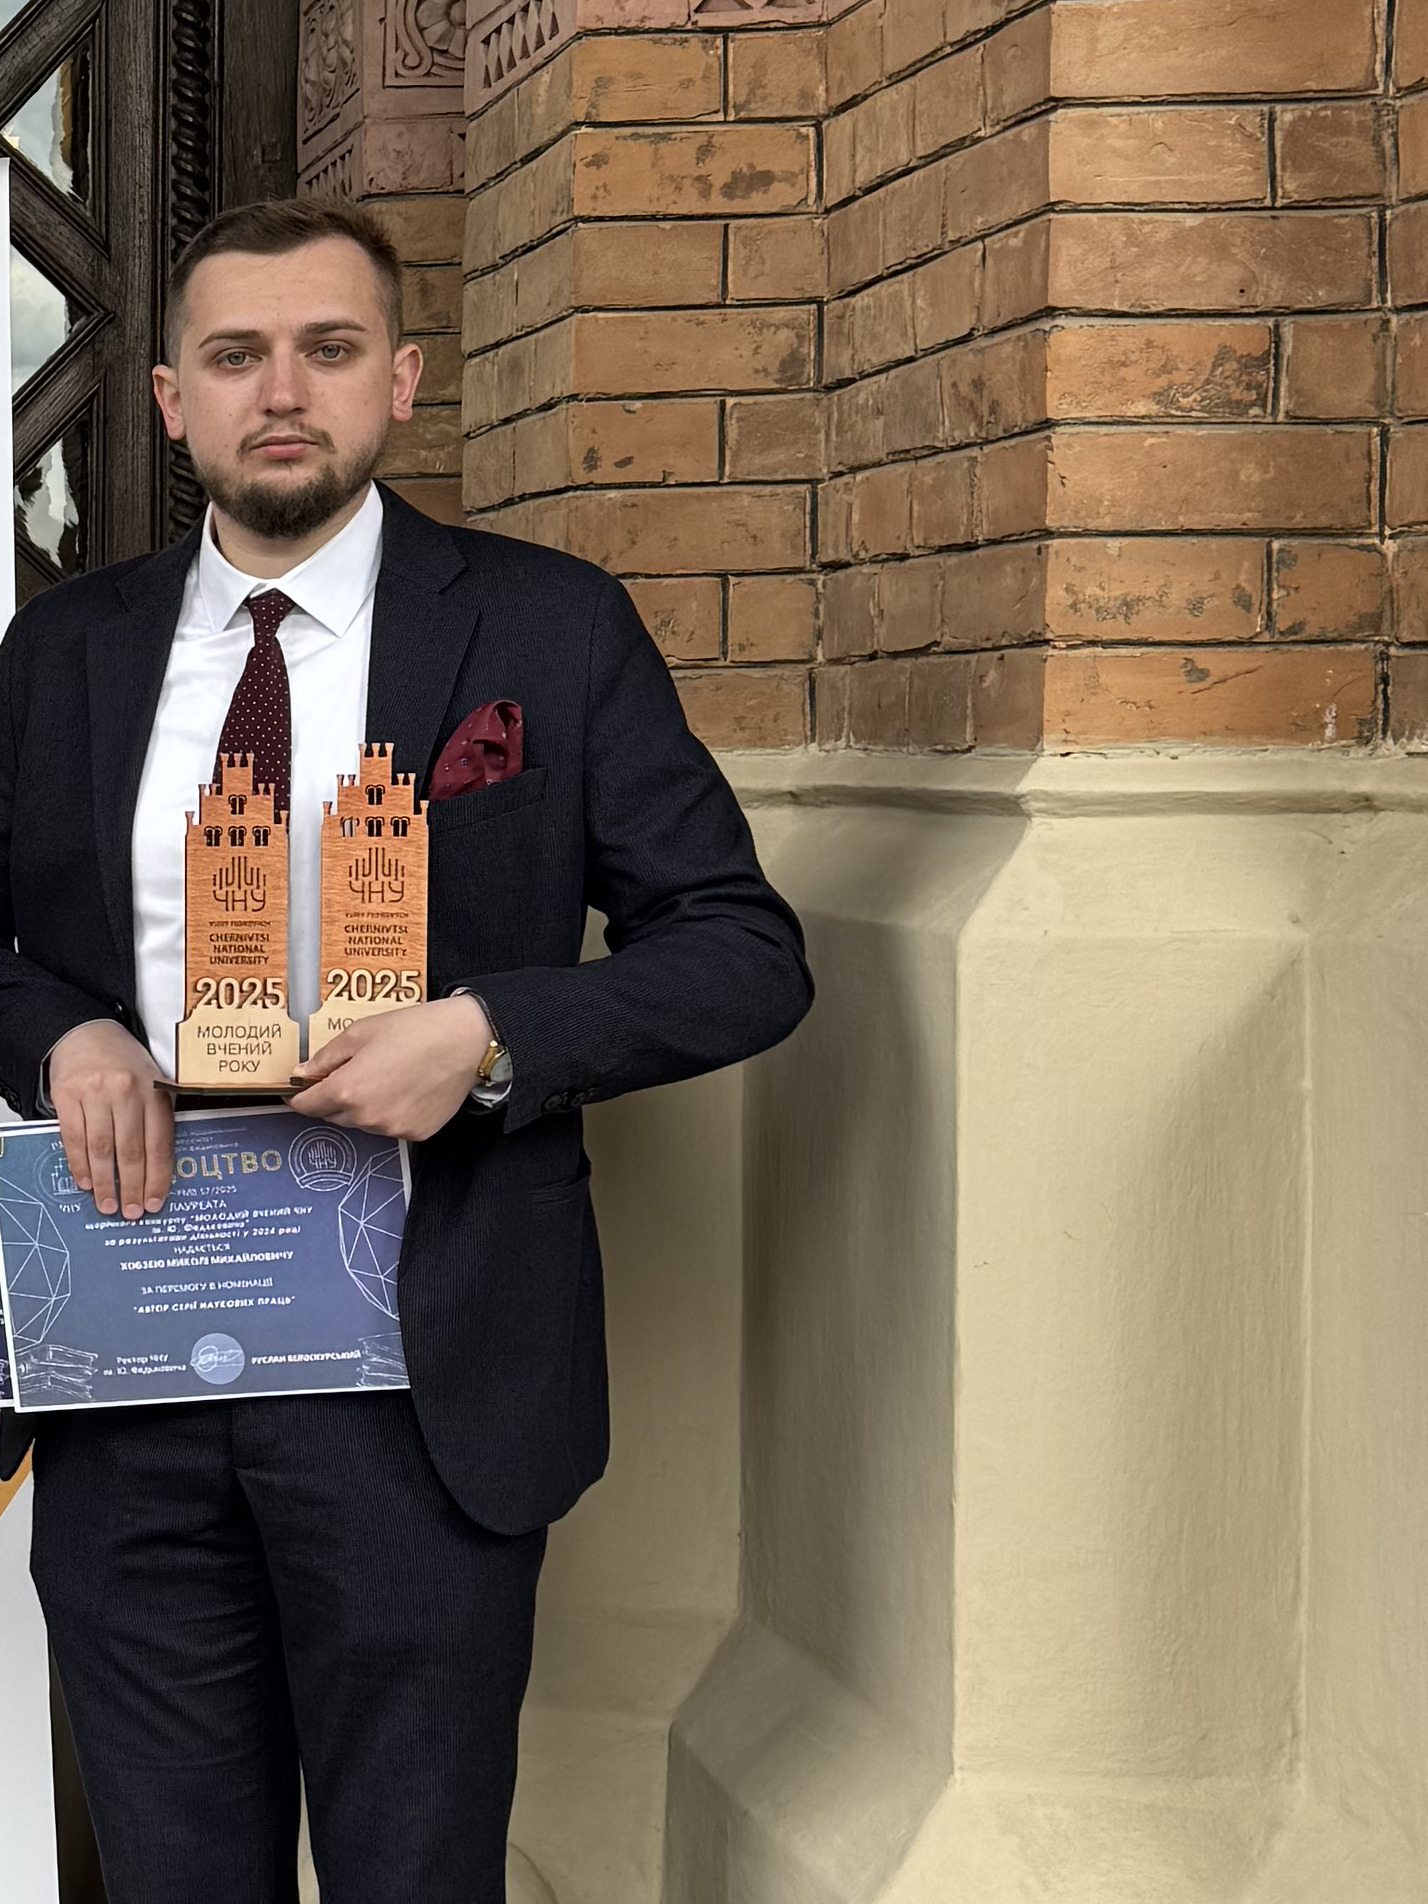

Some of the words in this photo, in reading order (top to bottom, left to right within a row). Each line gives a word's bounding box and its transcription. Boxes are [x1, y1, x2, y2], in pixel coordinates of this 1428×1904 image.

[348, 935, 404, 946] NATIONAL
[213, 944, 265, 954] NATIONAL
[344, 946, 408, 958] UNIVERSITY
[209, 955, 269, 965] UNIVERSITY
[327, 968, 422, 1003] 2025
[196, 977, 285, 1009] 2025
[197, 1024, 282, 1039] МОЛОДИЙ
[207, 1040, 272, 1056] ВЧЕНИЙ
[219, 1060, 260, 1073] РОКУ
[173, 1149, 283, 1183] ОЦТВО
